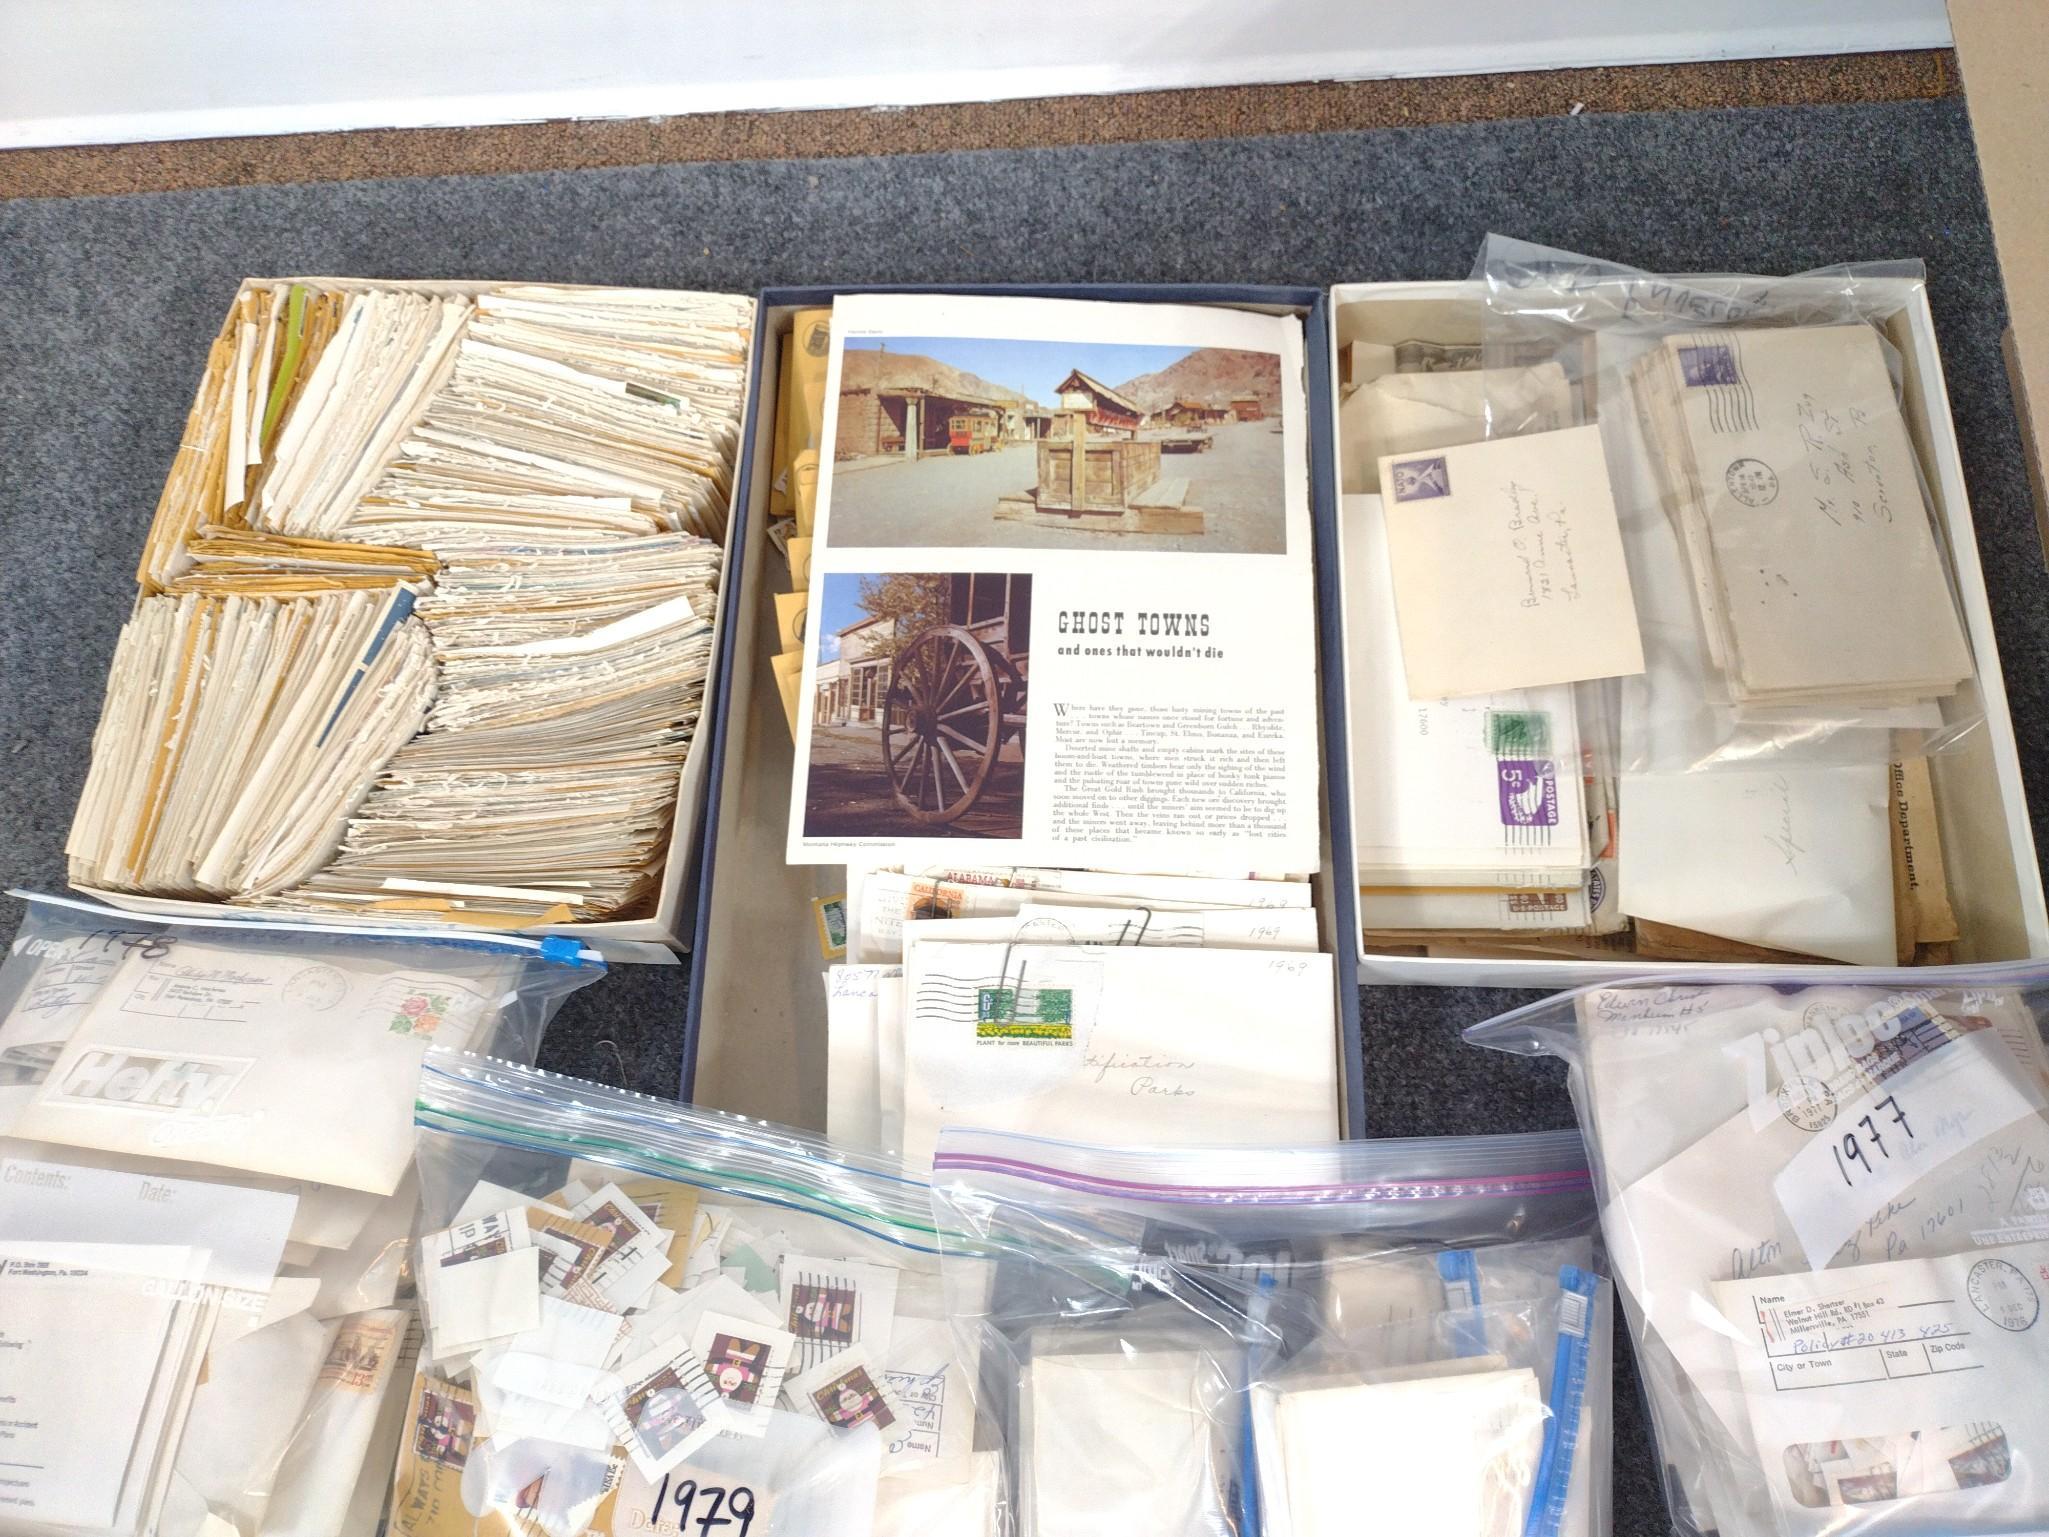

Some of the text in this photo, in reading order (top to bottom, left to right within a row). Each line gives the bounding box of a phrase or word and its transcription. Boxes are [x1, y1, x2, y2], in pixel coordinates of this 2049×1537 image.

[1058, 610, 1210, 637] GHOST TOWNS
[1057, 644, 1224, 659] and ones that wouldn't die
[1545, 780, 1557, 824] POSTAGE
[1898, 801, 1920, 890] Department,
[914, 884, 962, 900] CALIORNIA
[947, 871, 998, 887] ALABAMA
[79, 929, 178, 961] 1978
[1249, 926, 1281, 940] 1969
[1269, 960, 1308, 977] 1969
[1719, 1001, 1903, 1134] Ziploc
[61, 1049, 237, 1117] Hefty
[1130, 1076, 1195, 1097] Parks
[1833, 1095, 1913, 1187] 1977
[4, 1164, 177, 1202] Contents: Date:
[1919, 1198, 1964, 1242] 17601
[223, 1288, 271, 1311] SIZE
[1760, 1295, 1785, 1304] Name
[1786, 1314, 1813, 1326] Walnut
[1814, 1311, 1829, 1321] Hill
[1830, 1310, 1842, 1319] Rd.
[1843, 1306, 1853, 1315] RD
[1862, 1301, 1875, 1310] Box
[1876, 1298, 1885, 1306] 43
[1783, 1308, 1805, 1319] Elmer
[1837, 1316, 1848, 1325] PA
[1849, 1310, 1870, 1322] 17551
[1777, 1362, 1794, 1373] City
[1809, 1359, 1833, 1369] Town
[1886, 1349, 1908, 1359] State
[1930, 1344, 1943, 1354] Zip
[1946, 1342, 1966, 1351] Code
[907, 1441, 932, 1452] Name
[651, 1472, 756, 1537] 1979
